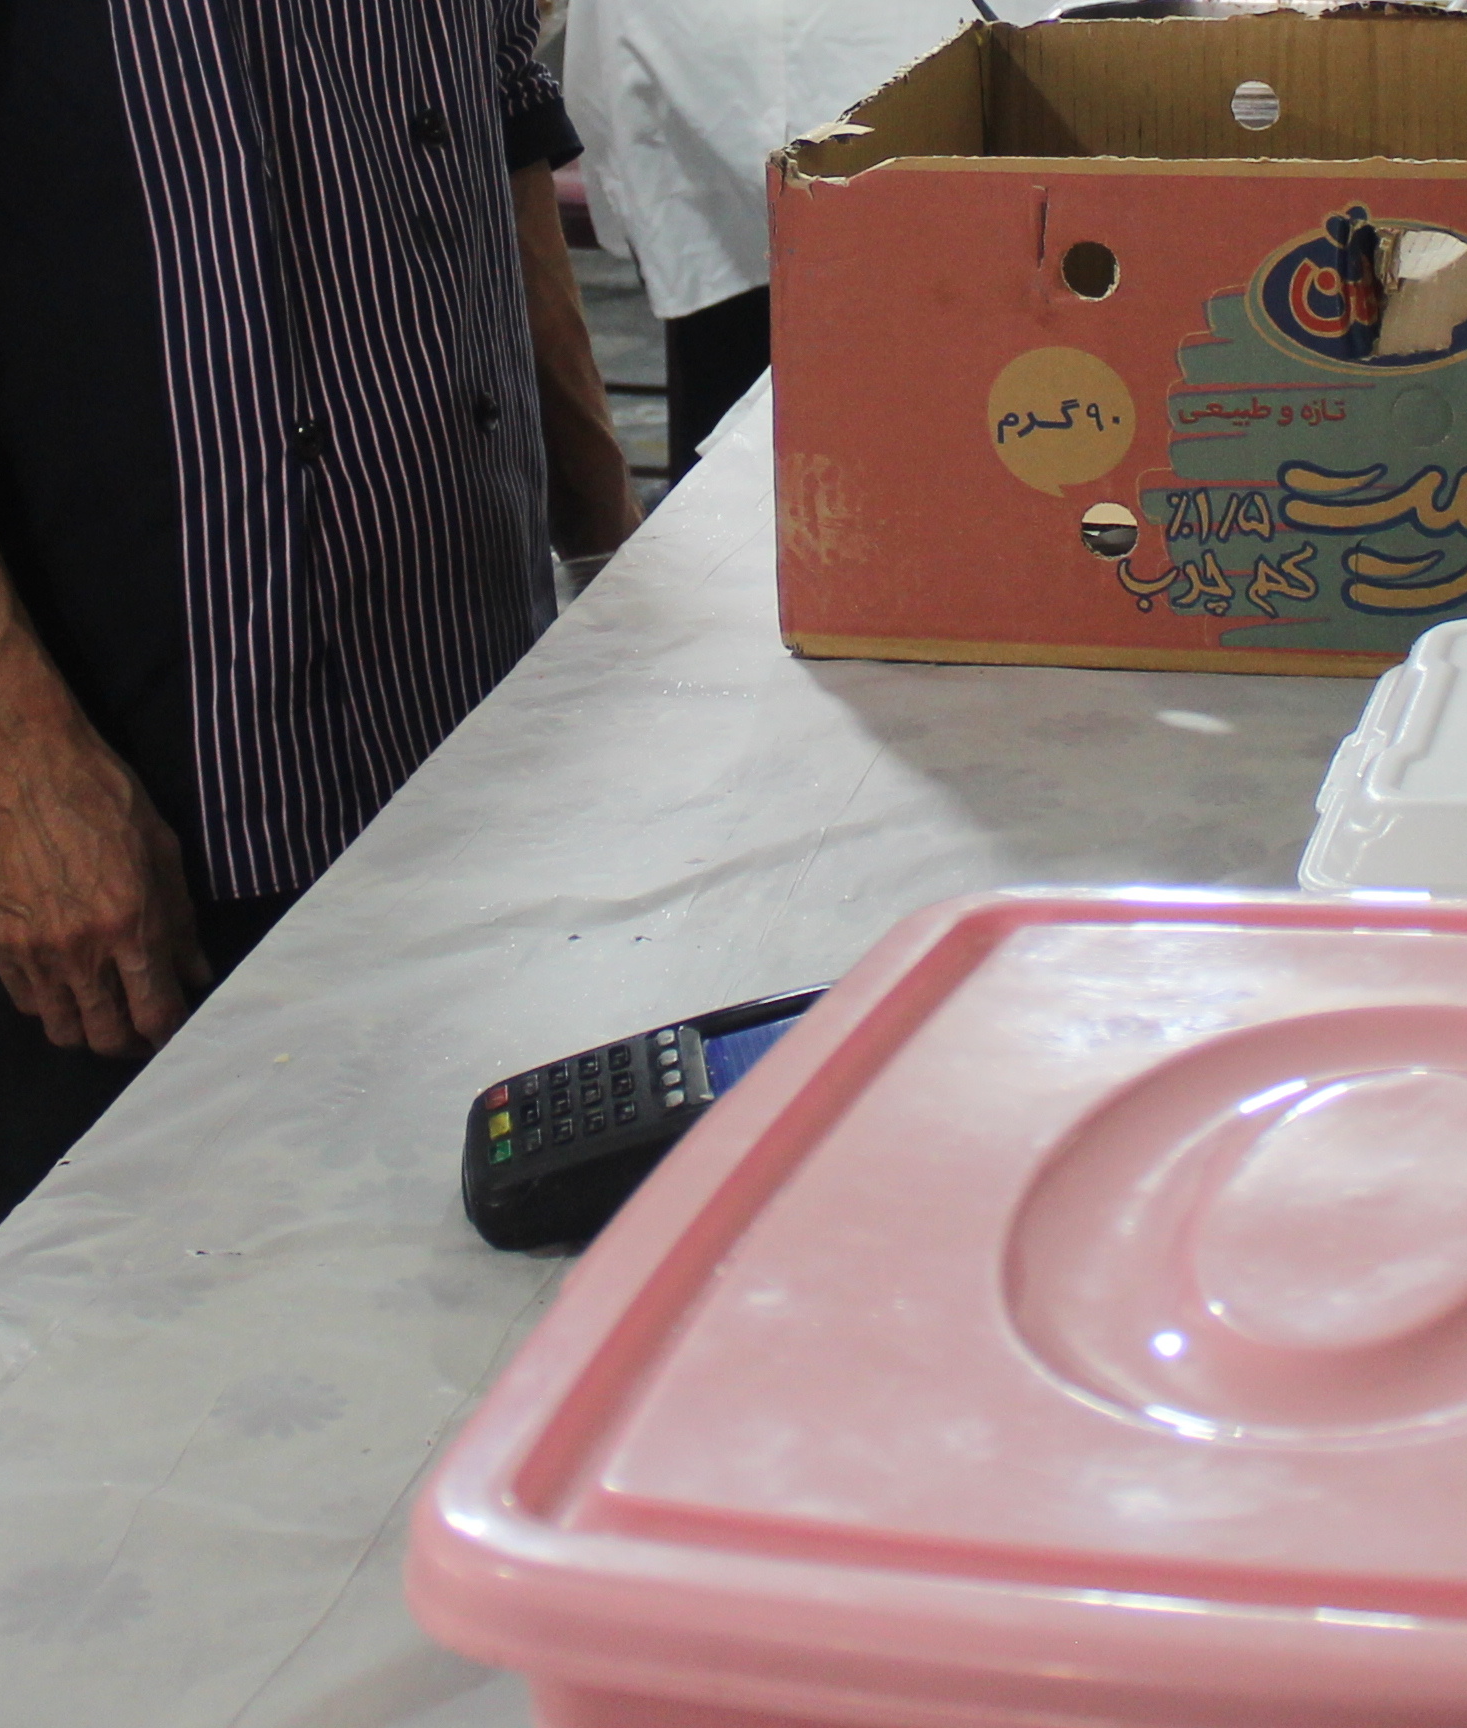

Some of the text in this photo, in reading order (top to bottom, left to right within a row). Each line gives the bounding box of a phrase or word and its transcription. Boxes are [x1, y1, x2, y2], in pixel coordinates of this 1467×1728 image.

[996, 398, 1081, 444] گرم
[1178, 397, 1346, 426] تازه و طبیعی
[1117, 541, 1320, 619] کم چرب
